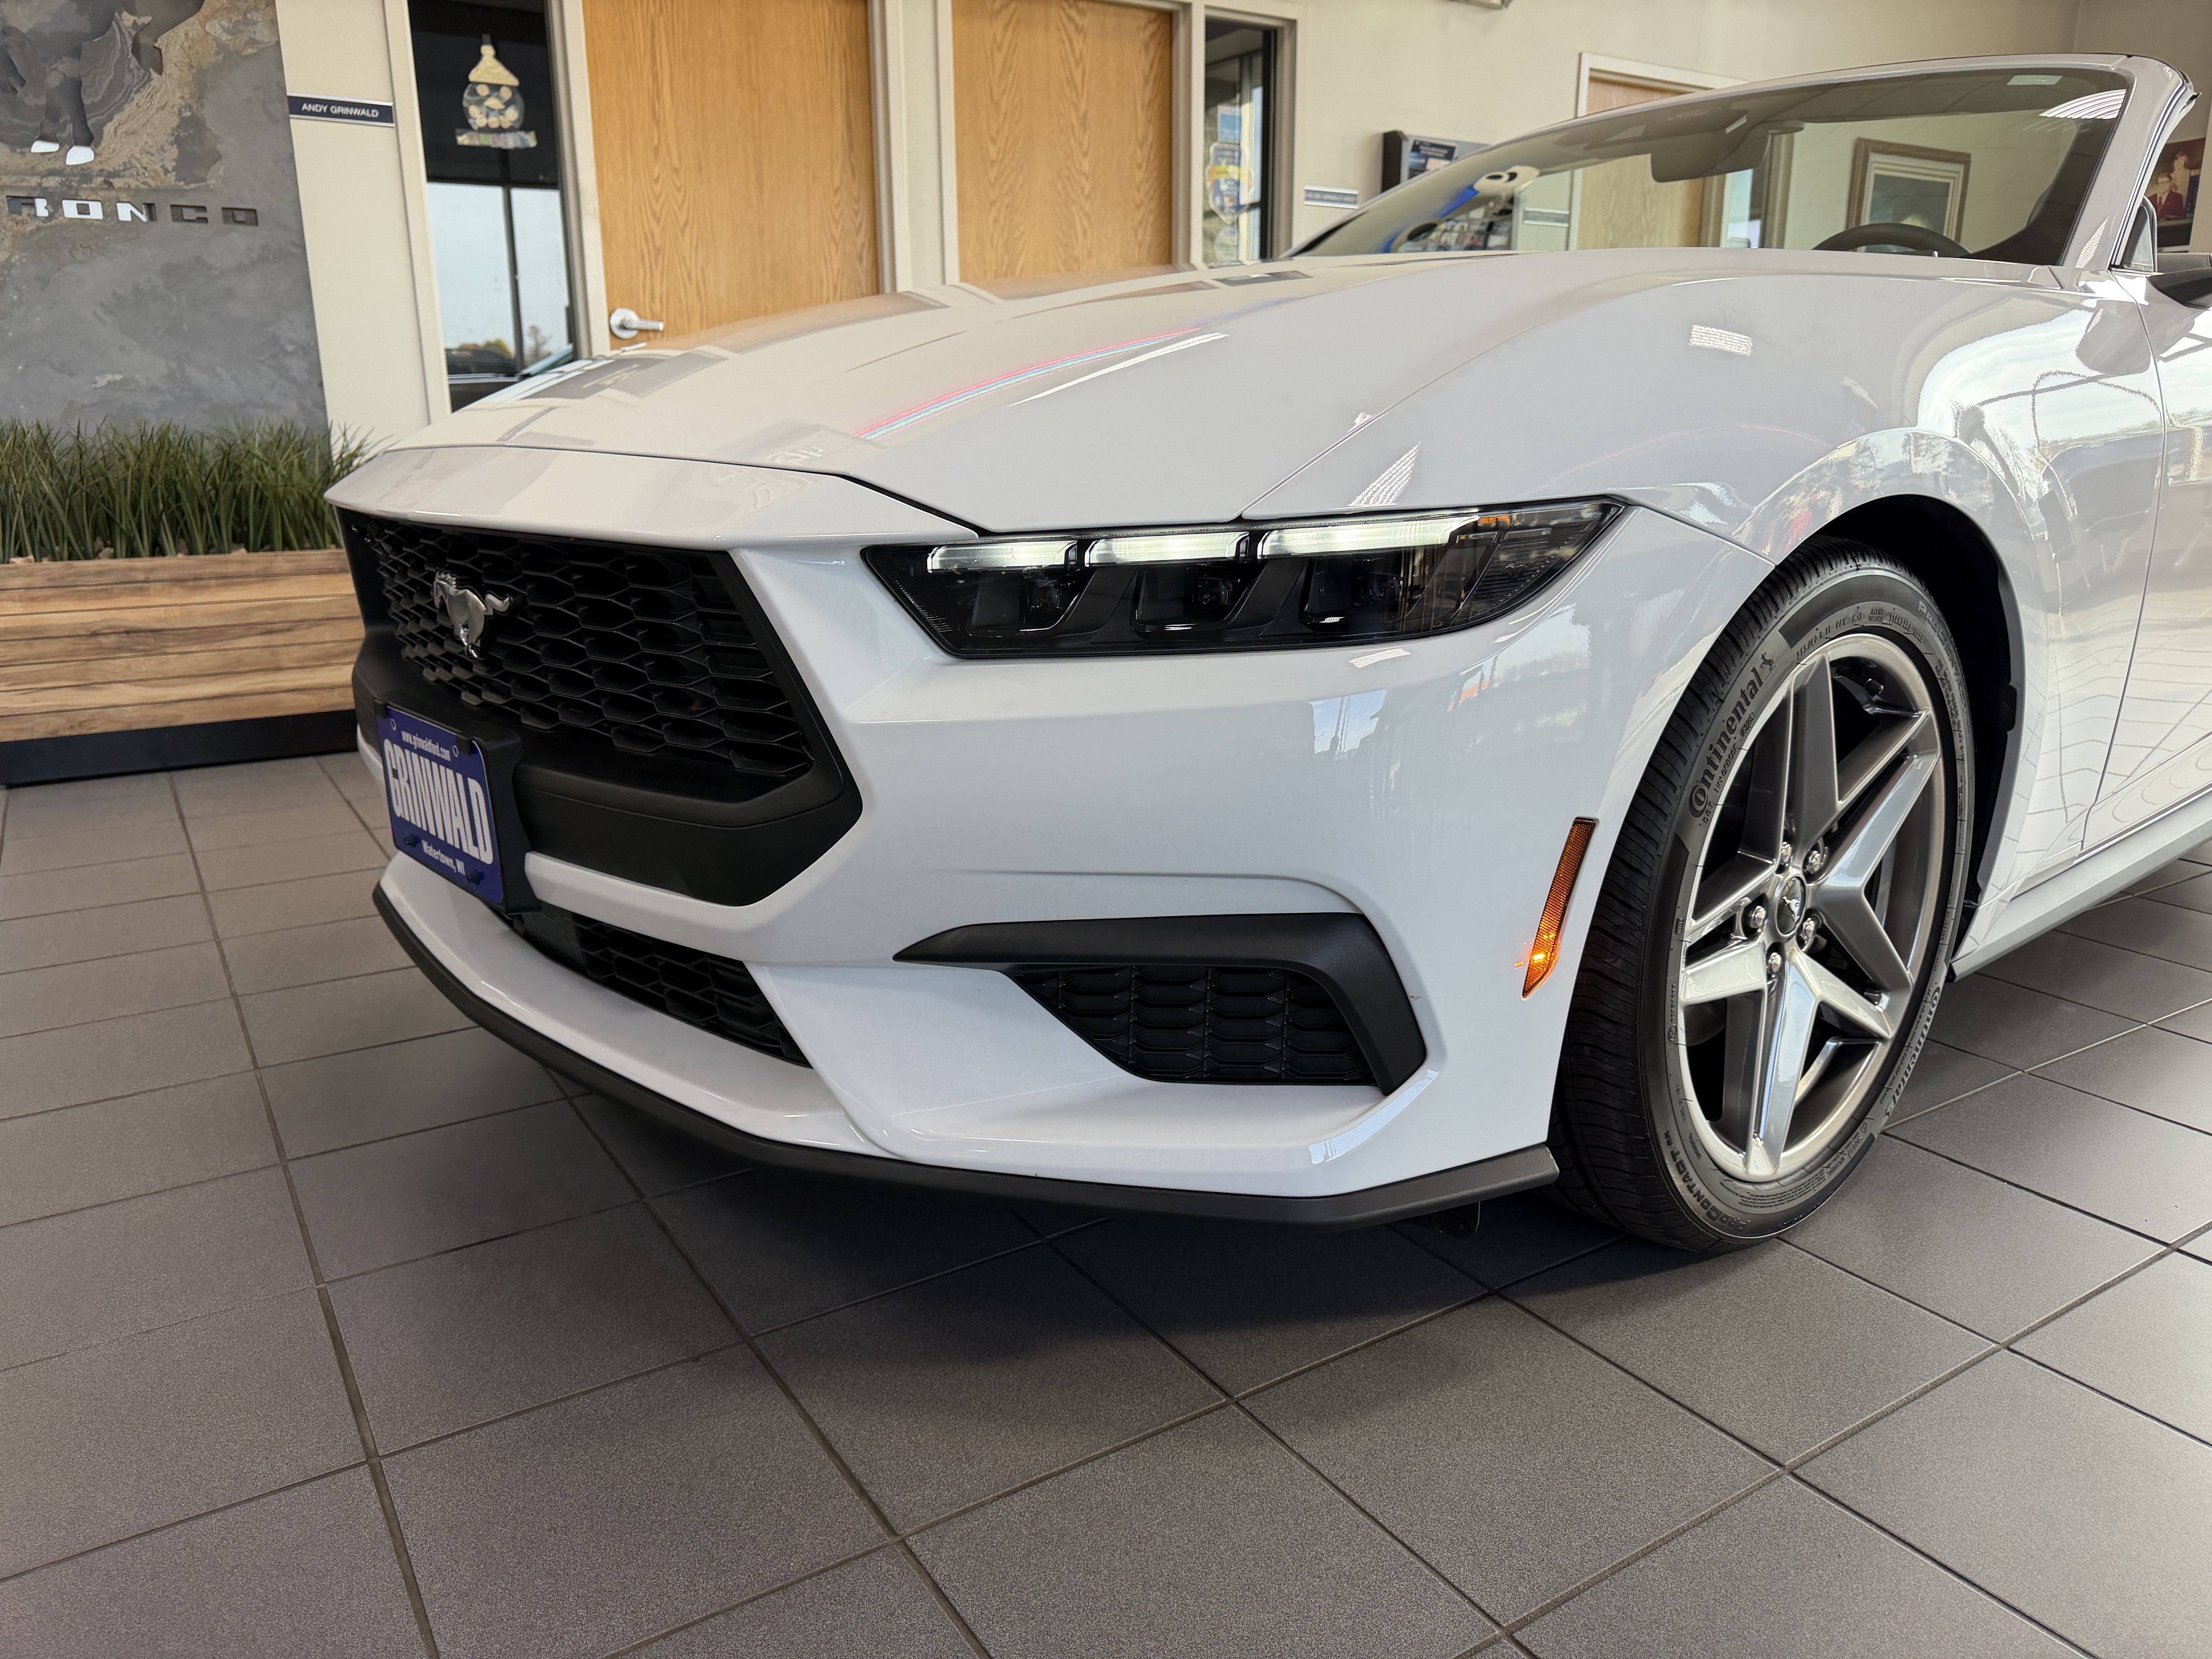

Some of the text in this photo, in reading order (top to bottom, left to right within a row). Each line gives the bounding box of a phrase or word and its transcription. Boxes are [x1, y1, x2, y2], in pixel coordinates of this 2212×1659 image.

[301, 102, 328, 113] ANDY
[401, 730, 451, 762] www.grinwaldford.com
[1688, 666, 1764, 818] Continental
[383, 738, 494, 865] GRINWALD
[421, 839, 466, 876] Watertown, WI
